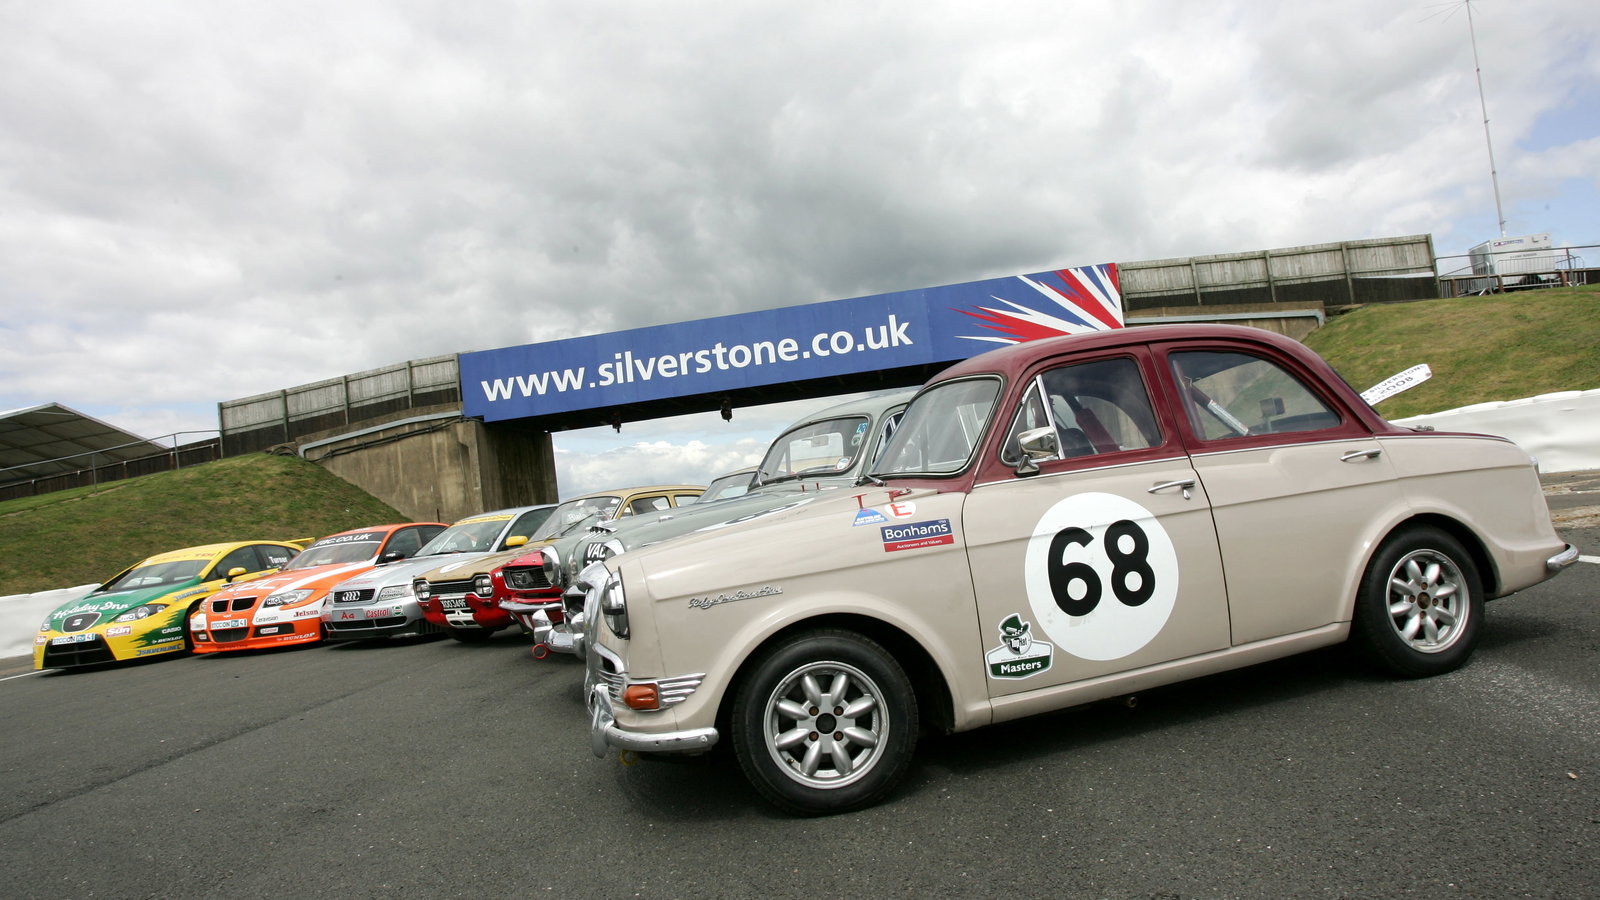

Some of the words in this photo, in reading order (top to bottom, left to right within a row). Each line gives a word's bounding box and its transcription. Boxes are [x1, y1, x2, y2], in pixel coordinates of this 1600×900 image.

[481, 314, 914, 402] www.silverstone.co.uk
[885, 524, 949, 540] Bonhams
[1047, 519, 1156, 617] 68
[53, 603, 100, 620] Holiday
[100, 601, 129, 611] Inn
[293, 609, 319, 618] Jelson
[365, 608, 389, 618] Castrol
[107, 627, 131, 636] Sun
[161, 626, 182, 635] CASIO
[284, 632, 316, 641] DUNLOP
[1000, 661, 1042, 675] Masters
